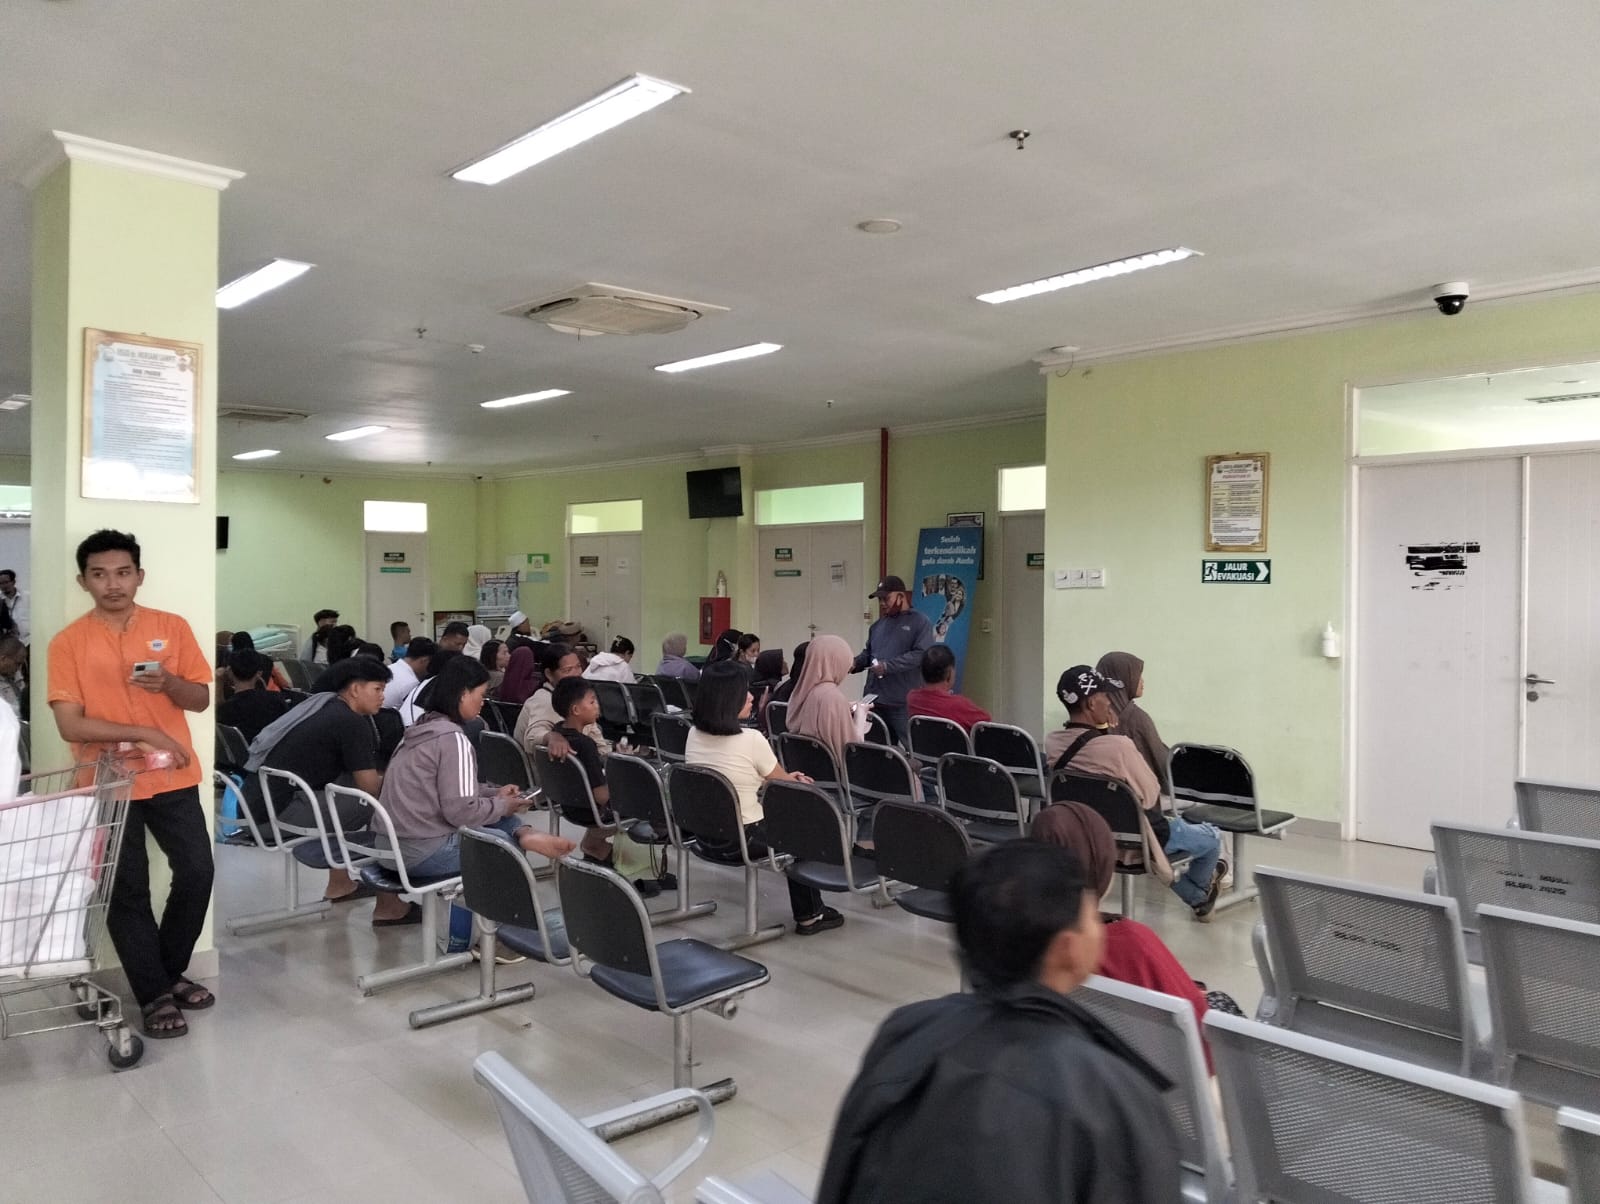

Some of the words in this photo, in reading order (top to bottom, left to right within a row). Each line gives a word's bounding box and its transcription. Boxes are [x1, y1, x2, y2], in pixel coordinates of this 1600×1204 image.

[924, 545, 977, 555] terkendalikah
[1224, 562, 1248, 571] JALUR
[1217, 572, 1255, 581] EVAKUASI
